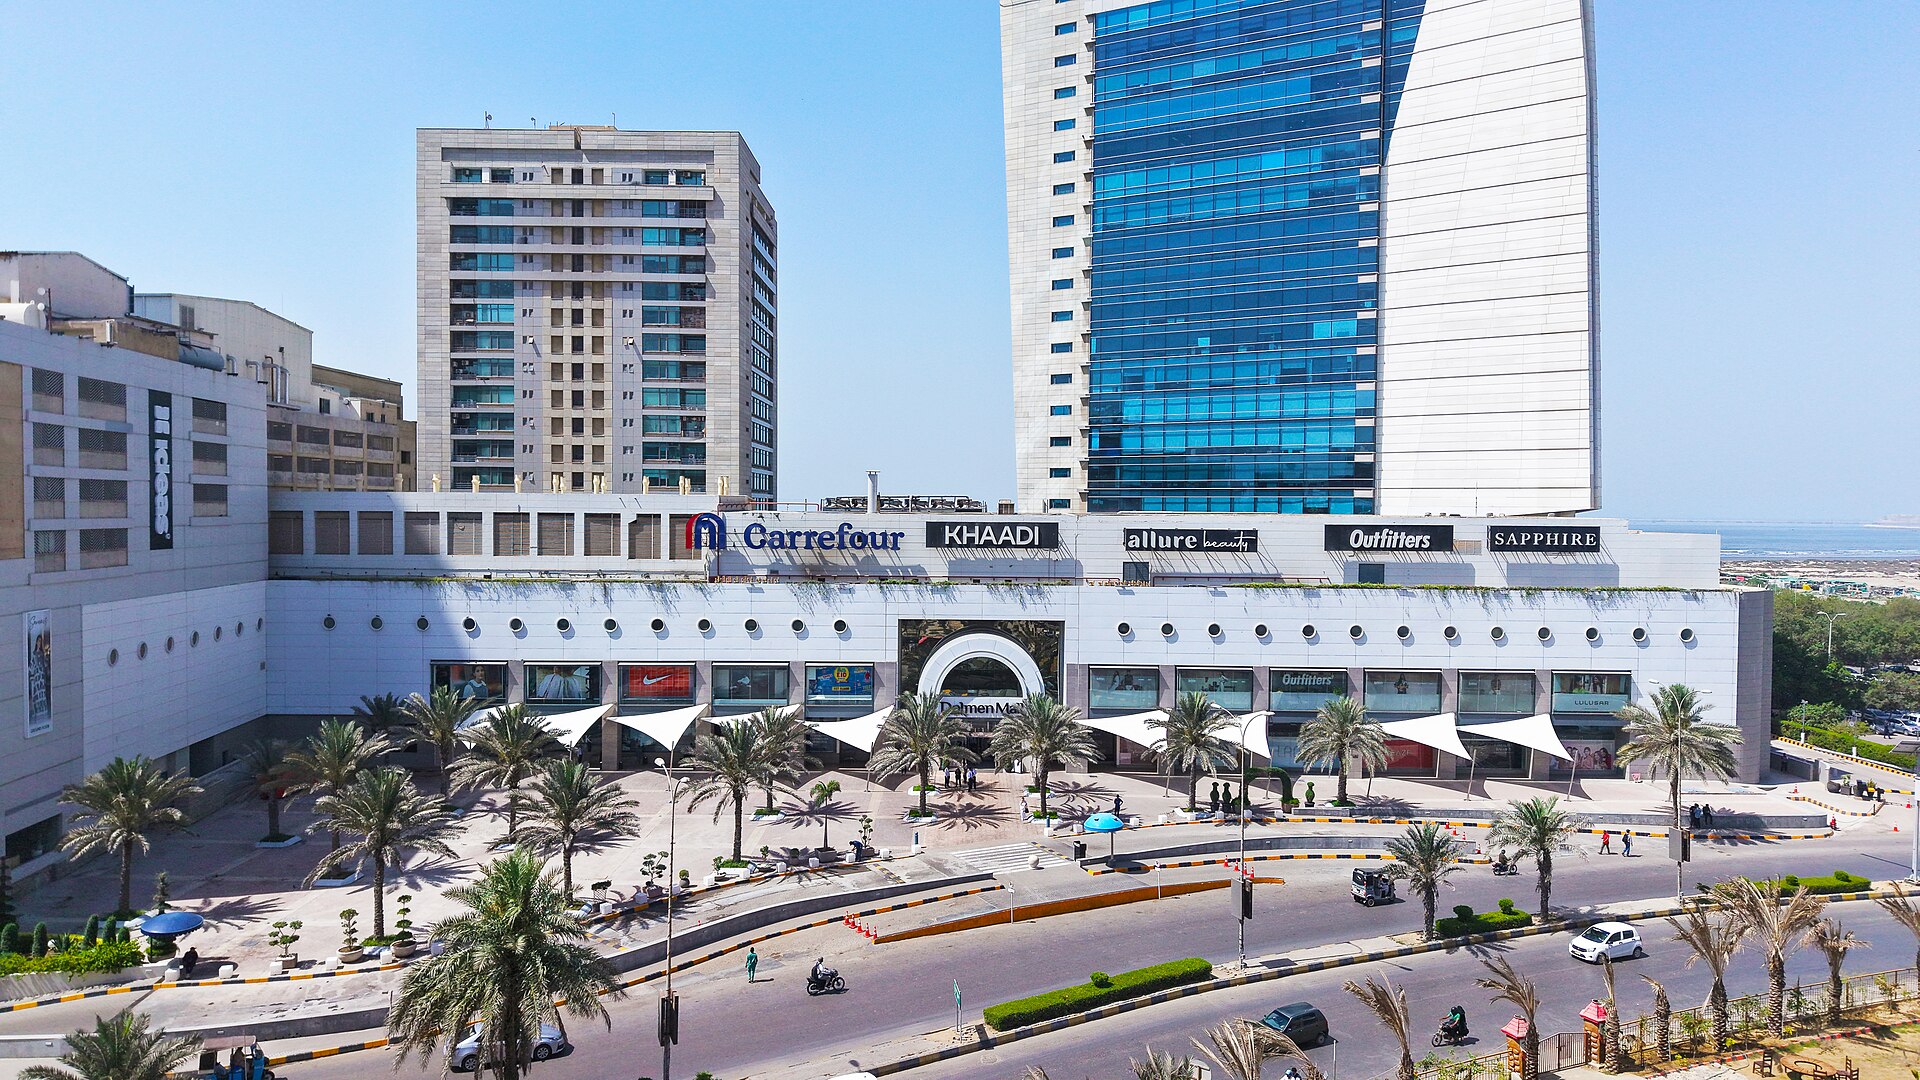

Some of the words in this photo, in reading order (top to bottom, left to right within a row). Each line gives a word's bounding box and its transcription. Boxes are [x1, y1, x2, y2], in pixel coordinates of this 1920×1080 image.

[154, 439, 171, 535] ideas
[743, 522, 905, 551] Carrefour
[944, 525, 1039, 546] KHAADI
[1127, 530, 1198, 549] allure
[1203, 530, 1256, 552] beauty
[1349, 528, 1431, 549] Outfitters
[1495, 532, 1597, 546] SAPPHIRE
[1282, 673, 1332, 686] Outfitters
[995, 702, 1024, 715] Ma
